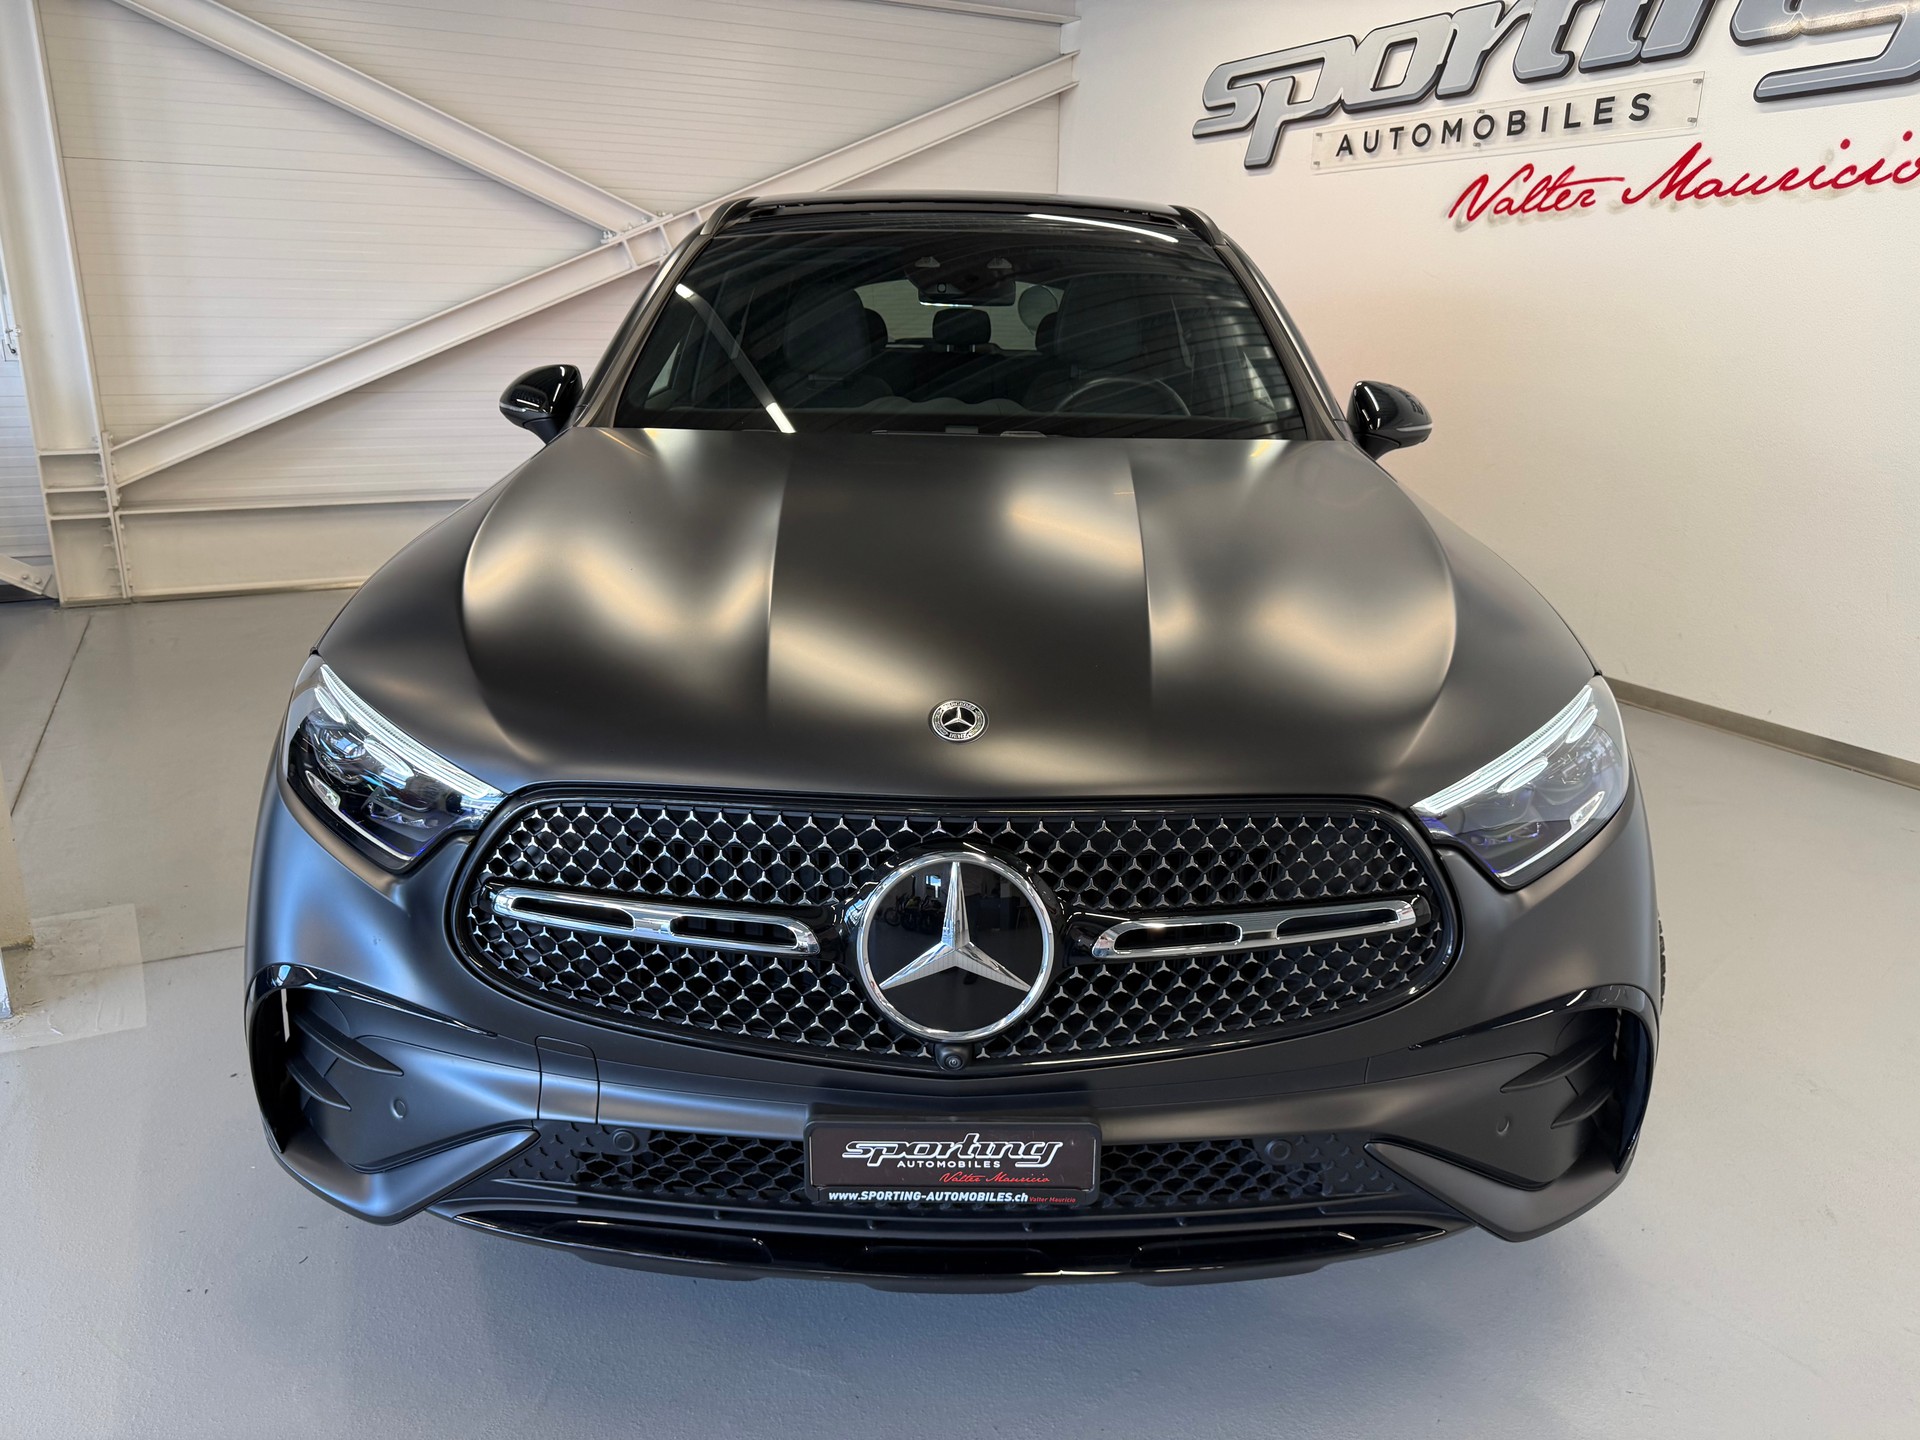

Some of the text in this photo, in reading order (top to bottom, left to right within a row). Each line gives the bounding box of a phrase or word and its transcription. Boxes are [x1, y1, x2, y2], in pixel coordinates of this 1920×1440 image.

[1335, 92, 1652, 157] AUTOMOBILES
[1448, 130, 1920, 222] Valter Mauricio
[842, 1132, 1064, 1168] sporting
[897, 1159, 1001, 1169] AUTOMOBILES
[939, 1171, 1050, 1184] Valter Mauricio
[828, 1190, 1029, 1203] www.SPORTING-AUTOMOBILES.ch
